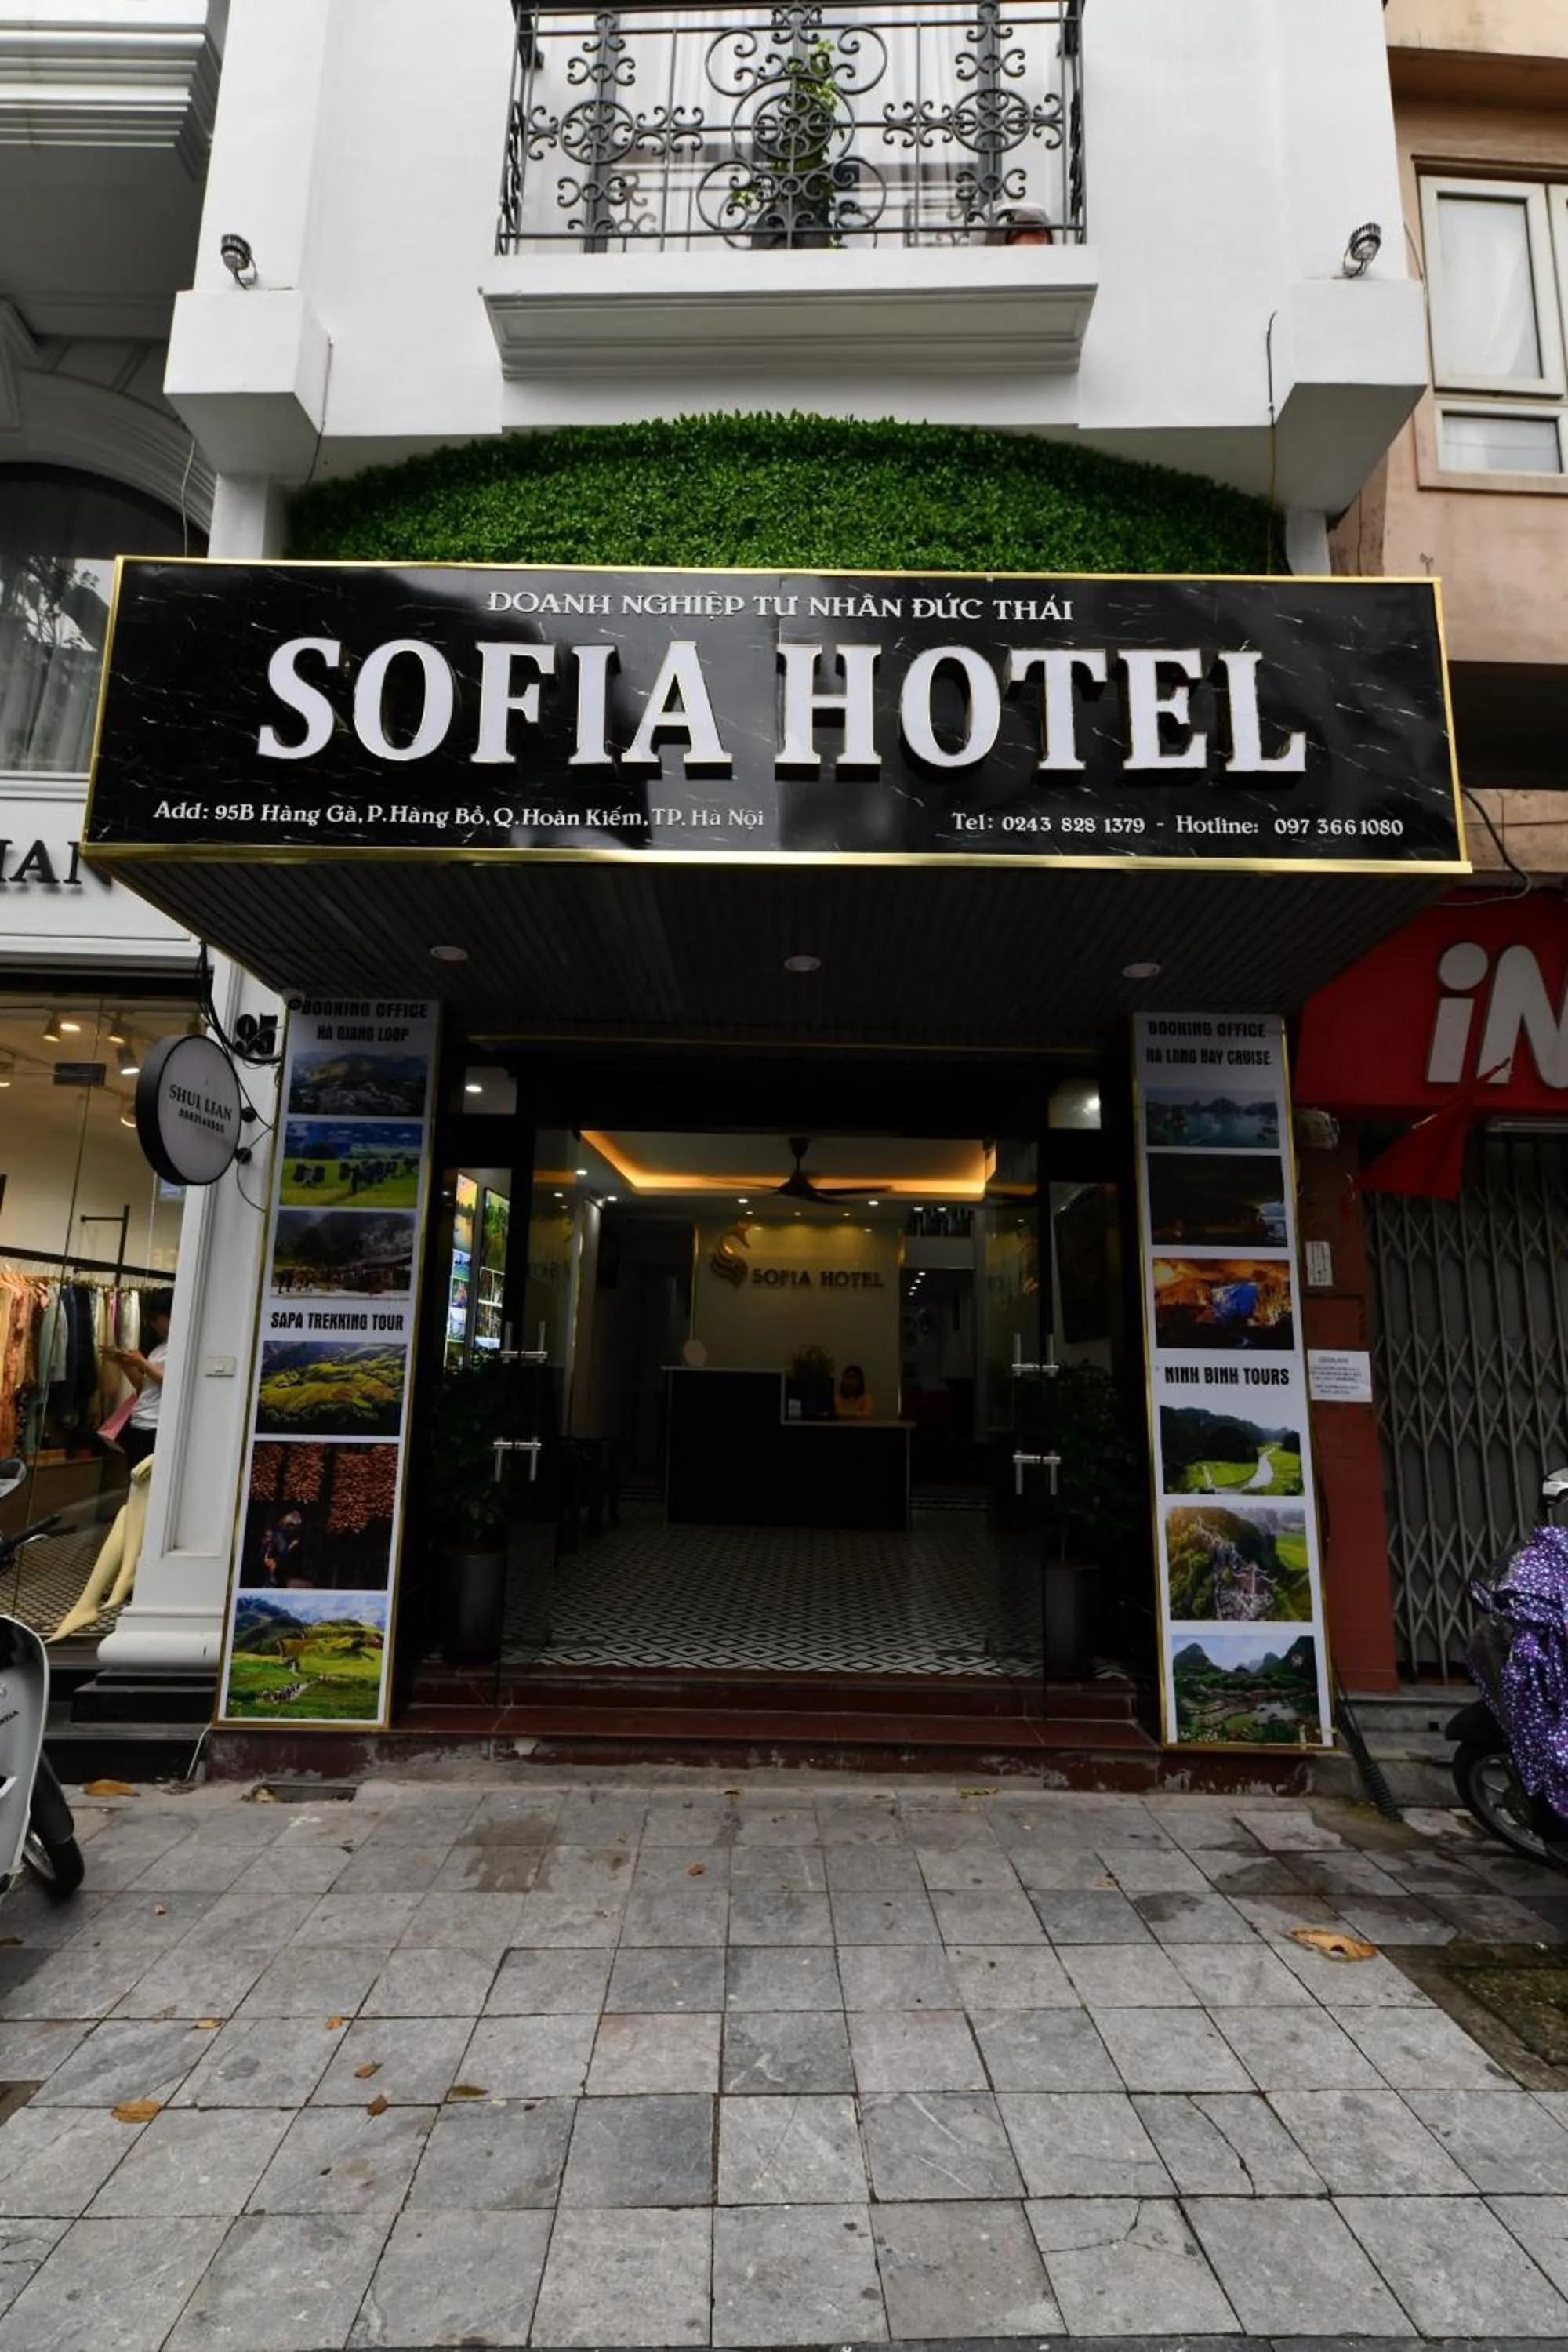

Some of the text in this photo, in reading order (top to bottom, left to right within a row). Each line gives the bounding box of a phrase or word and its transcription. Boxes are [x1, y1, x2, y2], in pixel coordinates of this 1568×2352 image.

[488, 591, 613, 615] DOANH
[620, 591, 745, 620] NGHIỆP
[808, 593, 902, 618] NHÂN
[912, 593, 983, 619] ĐỨC
[993, 594, 1073, 620] THÁI
[257, 637, 1307, 775] SOFIA HOTEL
[154, 801, 209, 820] Add:
[214, 804, 255, 821] 95B
[260, 804, 320, 826] Hàng
[652, 808, 687, 826] TP.
[691, 808, 721, 826] Hà
[728, 808, 764, 829] Nội
[952, 812, 993, 830] Tel:
[1001, 816, 1051, 832] 0243
[1060, 818, 1097, 833] 828
[1104, 818, 1145, 833] 1379
[1175, 815, 1258, 834] Hotline:
[1273, 818, 1310, 834] 097
[376, 1002, 429, 1018] OFFICE
[1217, 1022, 1267, 1038] OFFICE
[1166, 1049, 1197, 1064] LONG
[1227, 1050, 1272, 1065] CRUISE
[752, 1268, 884, 1288] SOFIA HOTEL
[270, 1312, 404, 1330] SAPA TREKKING TOUR
[1164, 1367, 1290, 1385] NINH BINH TOURS
